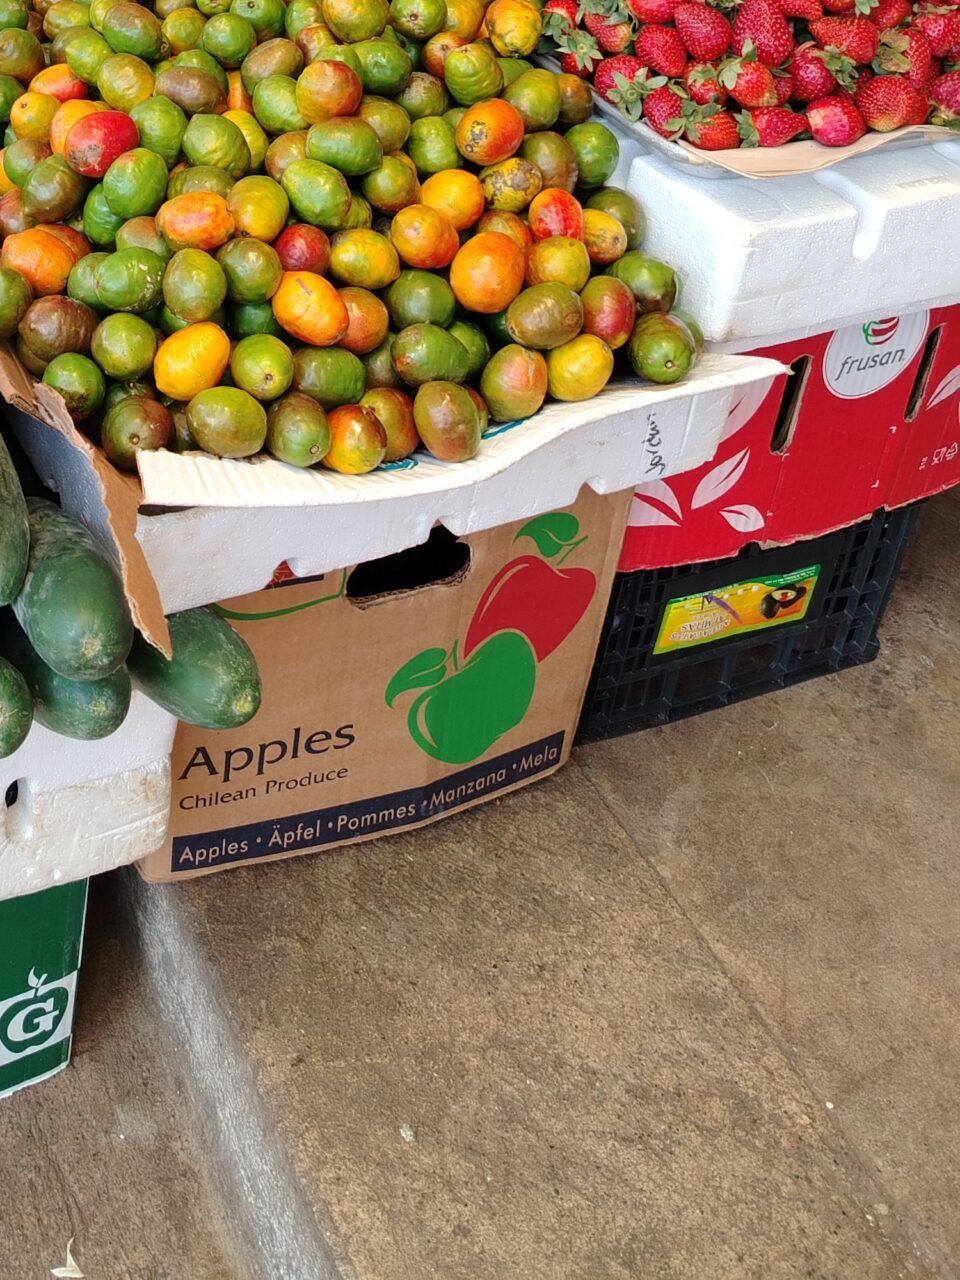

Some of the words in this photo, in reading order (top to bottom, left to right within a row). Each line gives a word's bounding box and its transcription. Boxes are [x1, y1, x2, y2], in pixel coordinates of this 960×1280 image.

[834, 348, 905, 381] frusan
[177, 723, 356, 783] Apples
[178, 838, 249, 866] Apples
[268, 820, 320, 849] Äpfel
[336, 801, 416, 833] Pommes
[429, 768, 507, 810] Manzana
[519, 745, 558, 773] Mela
[179, 786, 257, 811] Chilean
[265, 767, 349, 795] Produce
